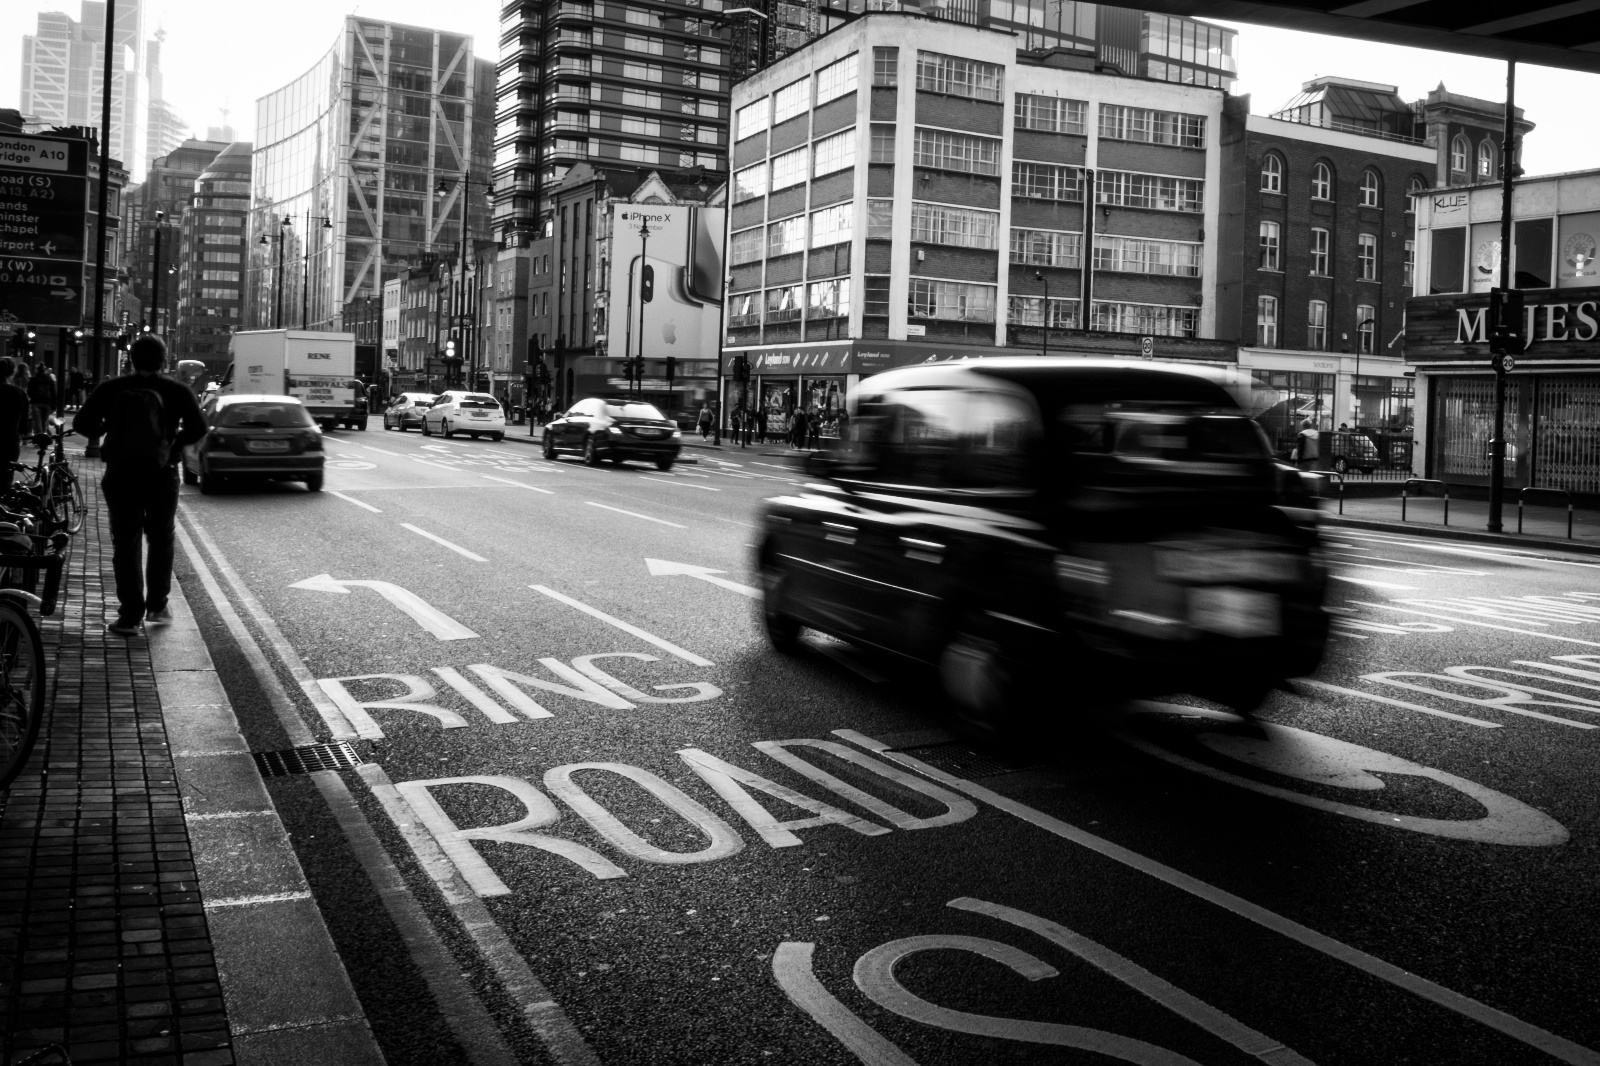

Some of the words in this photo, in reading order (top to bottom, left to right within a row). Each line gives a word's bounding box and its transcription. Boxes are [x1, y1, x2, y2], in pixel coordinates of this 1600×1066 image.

[40, 150, 65, 160] A10
[29, 175, 51, 188] (S)
[29, 188, 55, 200] A2)
[1433, 195, 1467, 213] KLUE
[630, 212, 662, 222] iPhone
[664, 213, 671, 222] X
[8, 260, 33, 272] (W)
[17, 274, 47, 285] A41)
[1454, 301, 1598, 350] MJES
[1503, 358, 1513, 367] 20
[297, 380, 348, 389] REMOVALS
[319, 652, 723, 740] RING
[394, 738, 978, 898] ROAD
